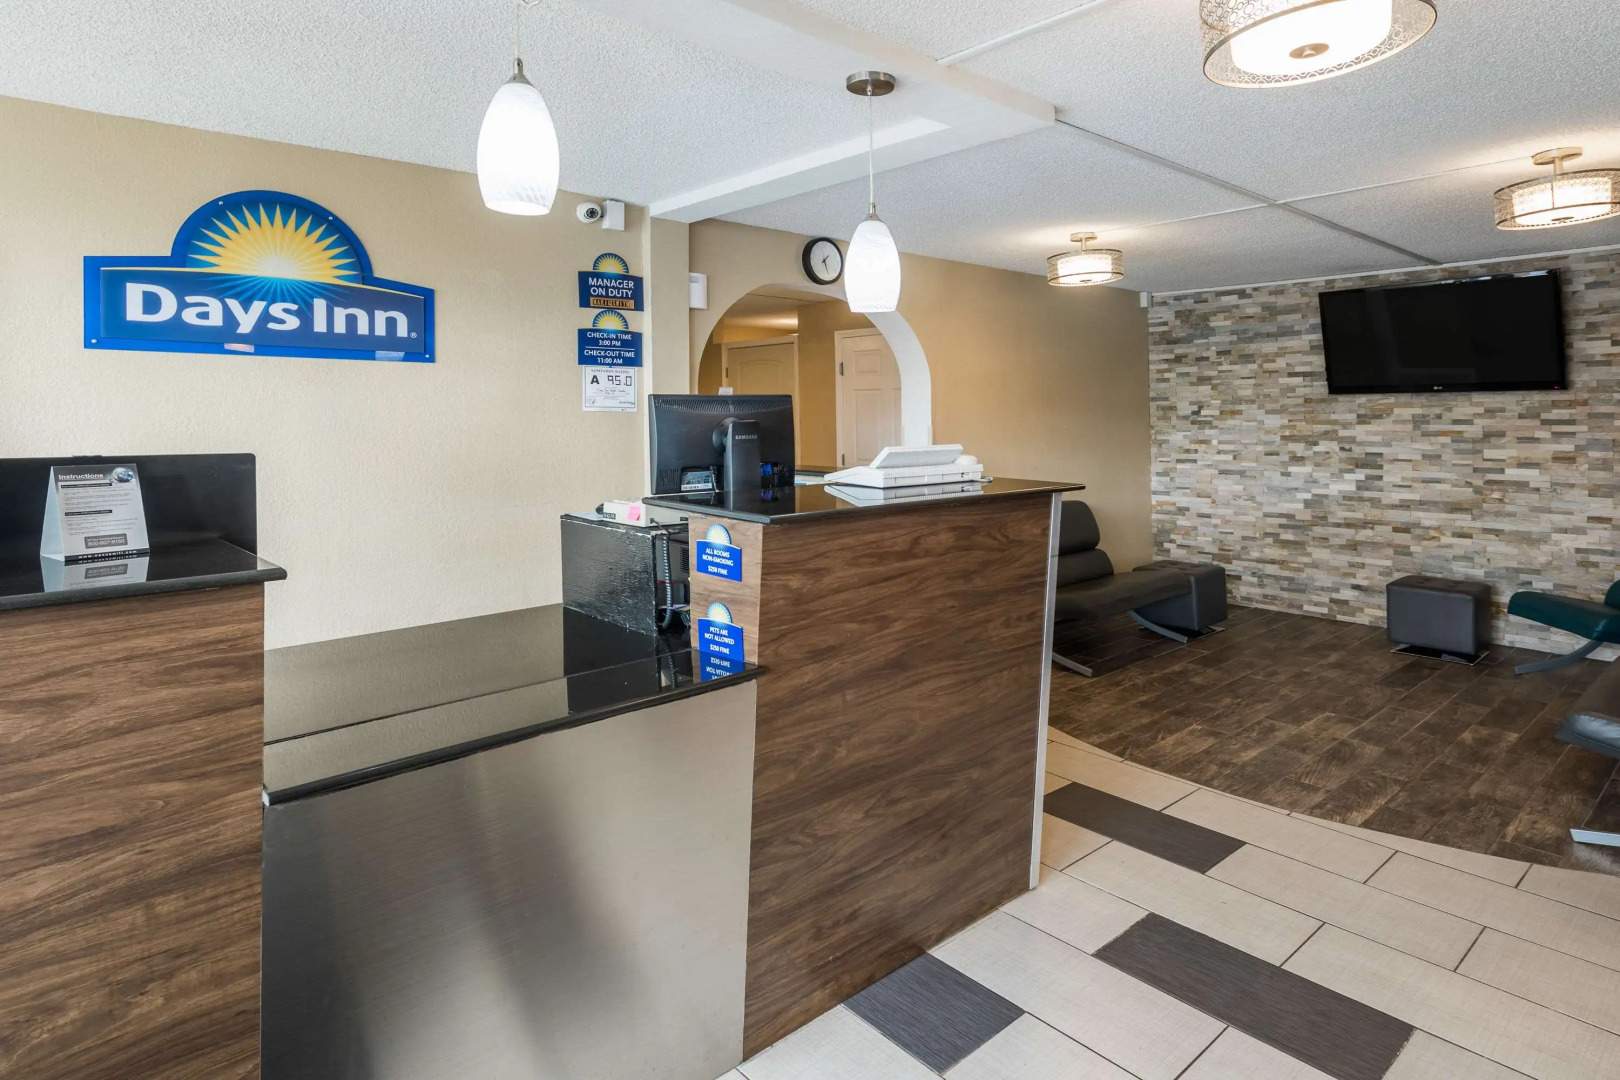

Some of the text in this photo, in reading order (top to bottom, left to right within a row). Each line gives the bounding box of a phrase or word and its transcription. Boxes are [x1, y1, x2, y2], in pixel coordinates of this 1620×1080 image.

[588, 277, 634, 289] MANAGER
[590, 287, 633, 298] ON DUTY
[126, 282, 300, 334] Days
[586, 331, 616, 340] CHECK-IN
[583, 349, 620, 357] CHECK-OUT
[590, 374, 600, 385] A
[58, 472, 104, 480] Instructions
[705, 547, 730, 558] ALL ROOMS
[702, 554, 734, 567] NON-SMOKING
[718, 567, 728, 576] FINE
[709, 626, 729, 637] PETS ARE
[704, 632, 735, 645] NOT ALLOWED
[719, 646, 730, 655] FINE
